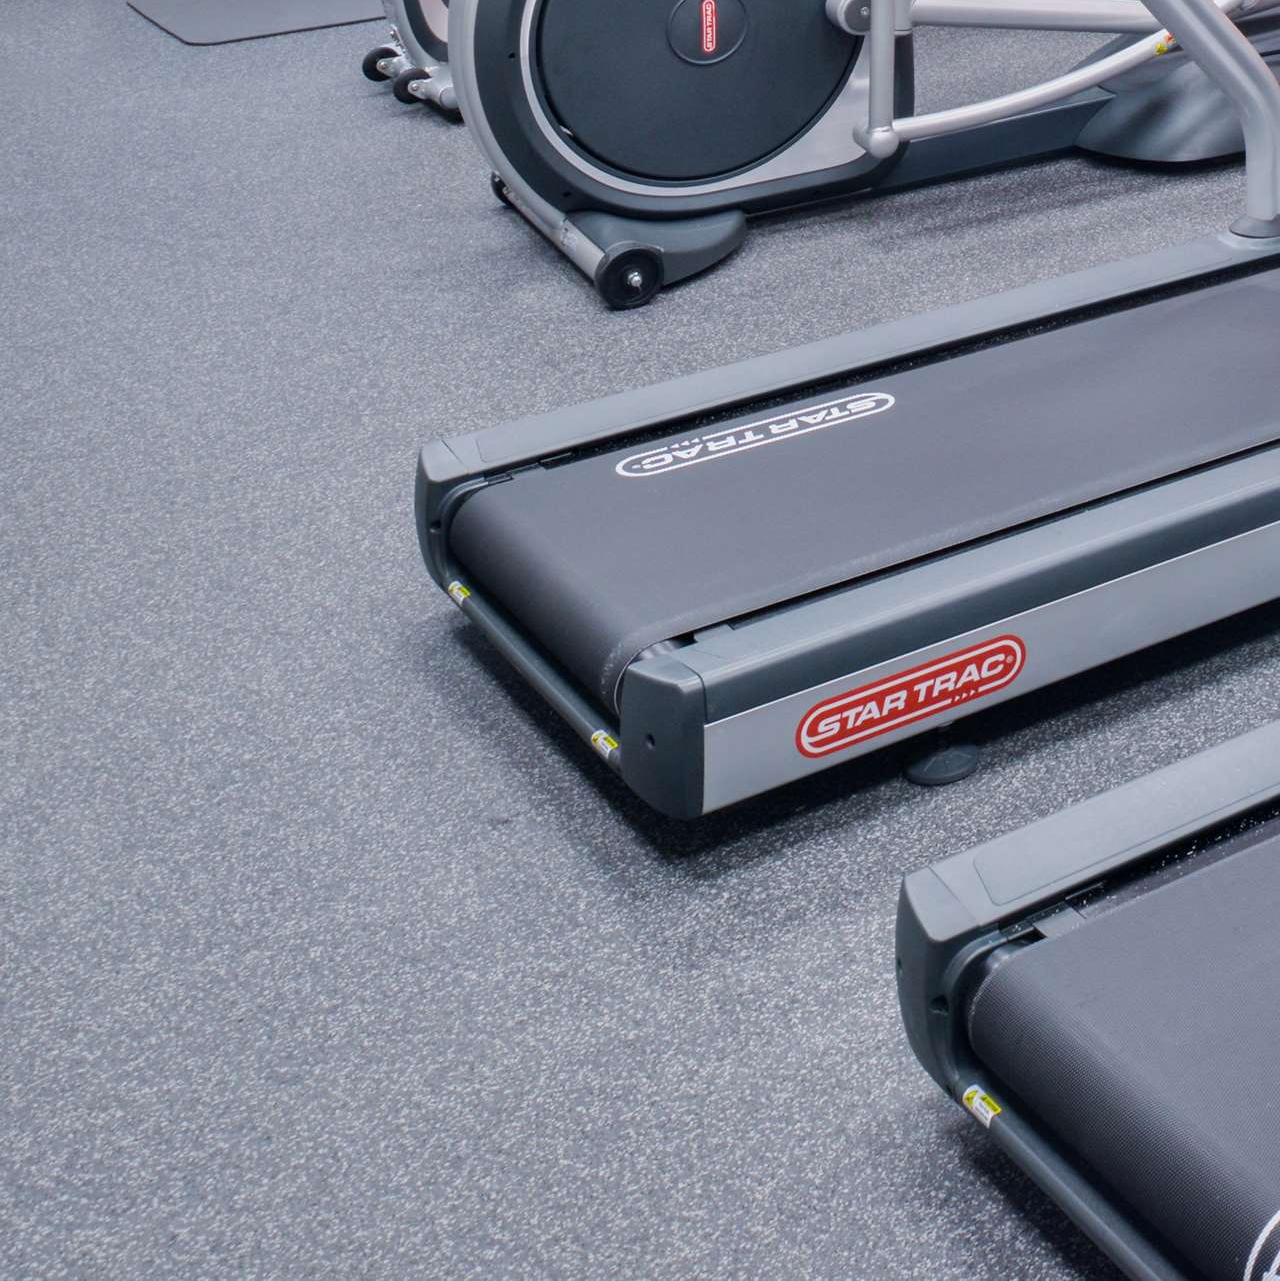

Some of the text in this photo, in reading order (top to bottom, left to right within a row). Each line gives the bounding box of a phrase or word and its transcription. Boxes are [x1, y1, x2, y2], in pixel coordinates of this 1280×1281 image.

[640, 398, 878, 471] STAR TRAC
[815, 653, 1006, 741] STAR TRAC
